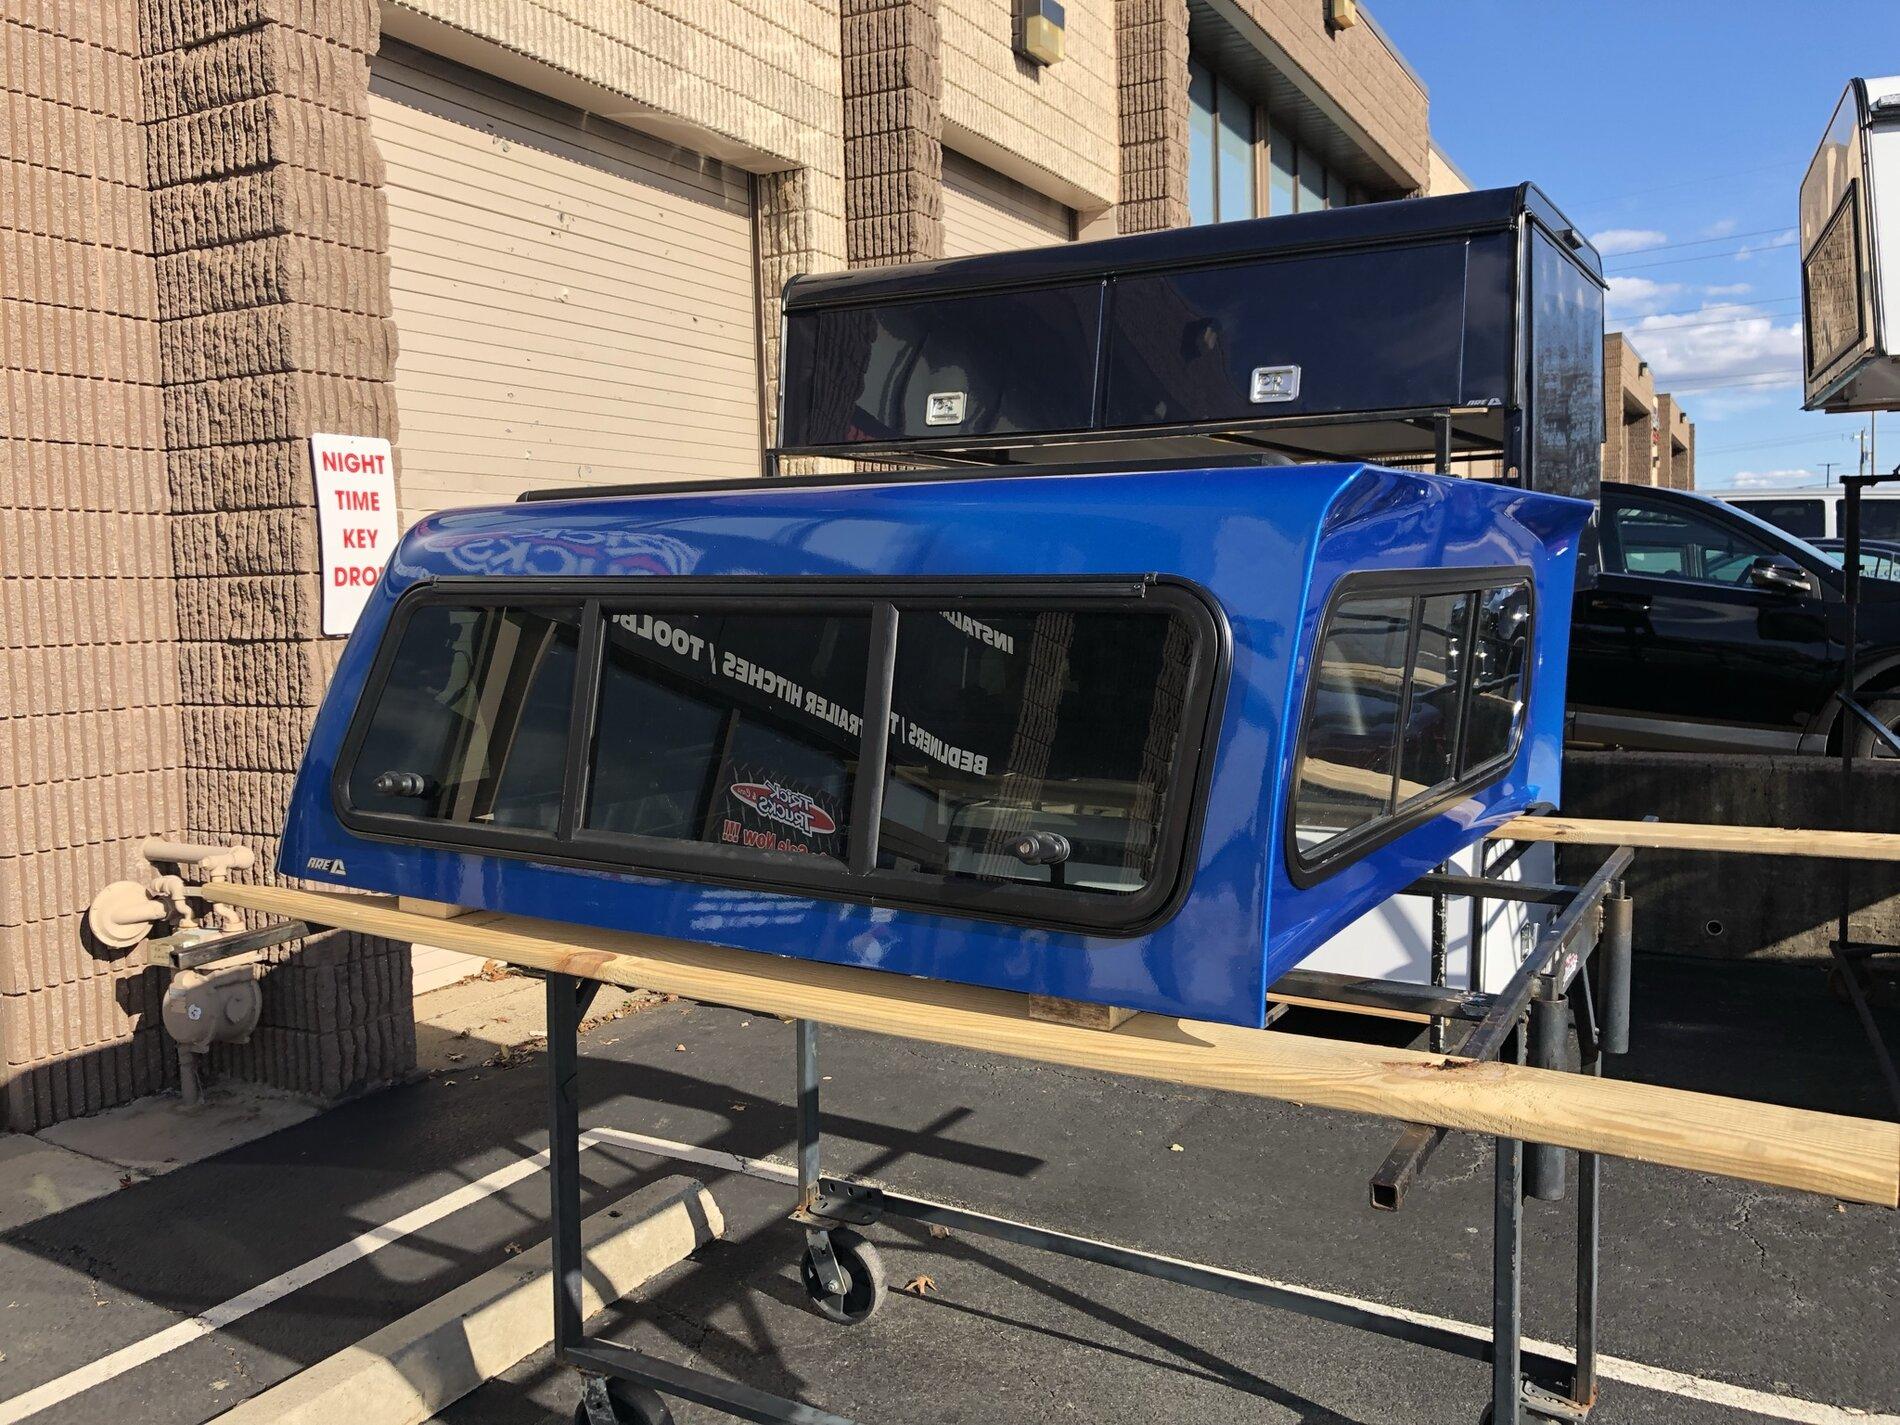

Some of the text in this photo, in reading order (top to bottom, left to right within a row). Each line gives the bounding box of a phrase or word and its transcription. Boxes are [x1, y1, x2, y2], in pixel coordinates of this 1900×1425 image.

[322, 451, 385, 475] NIGHT
[335, 489, 380, 512] TIME
[343, 528, 378, 549] KEY
[334, 566, 384, 588] DRO
[307, 856, 334, 871] ARE
